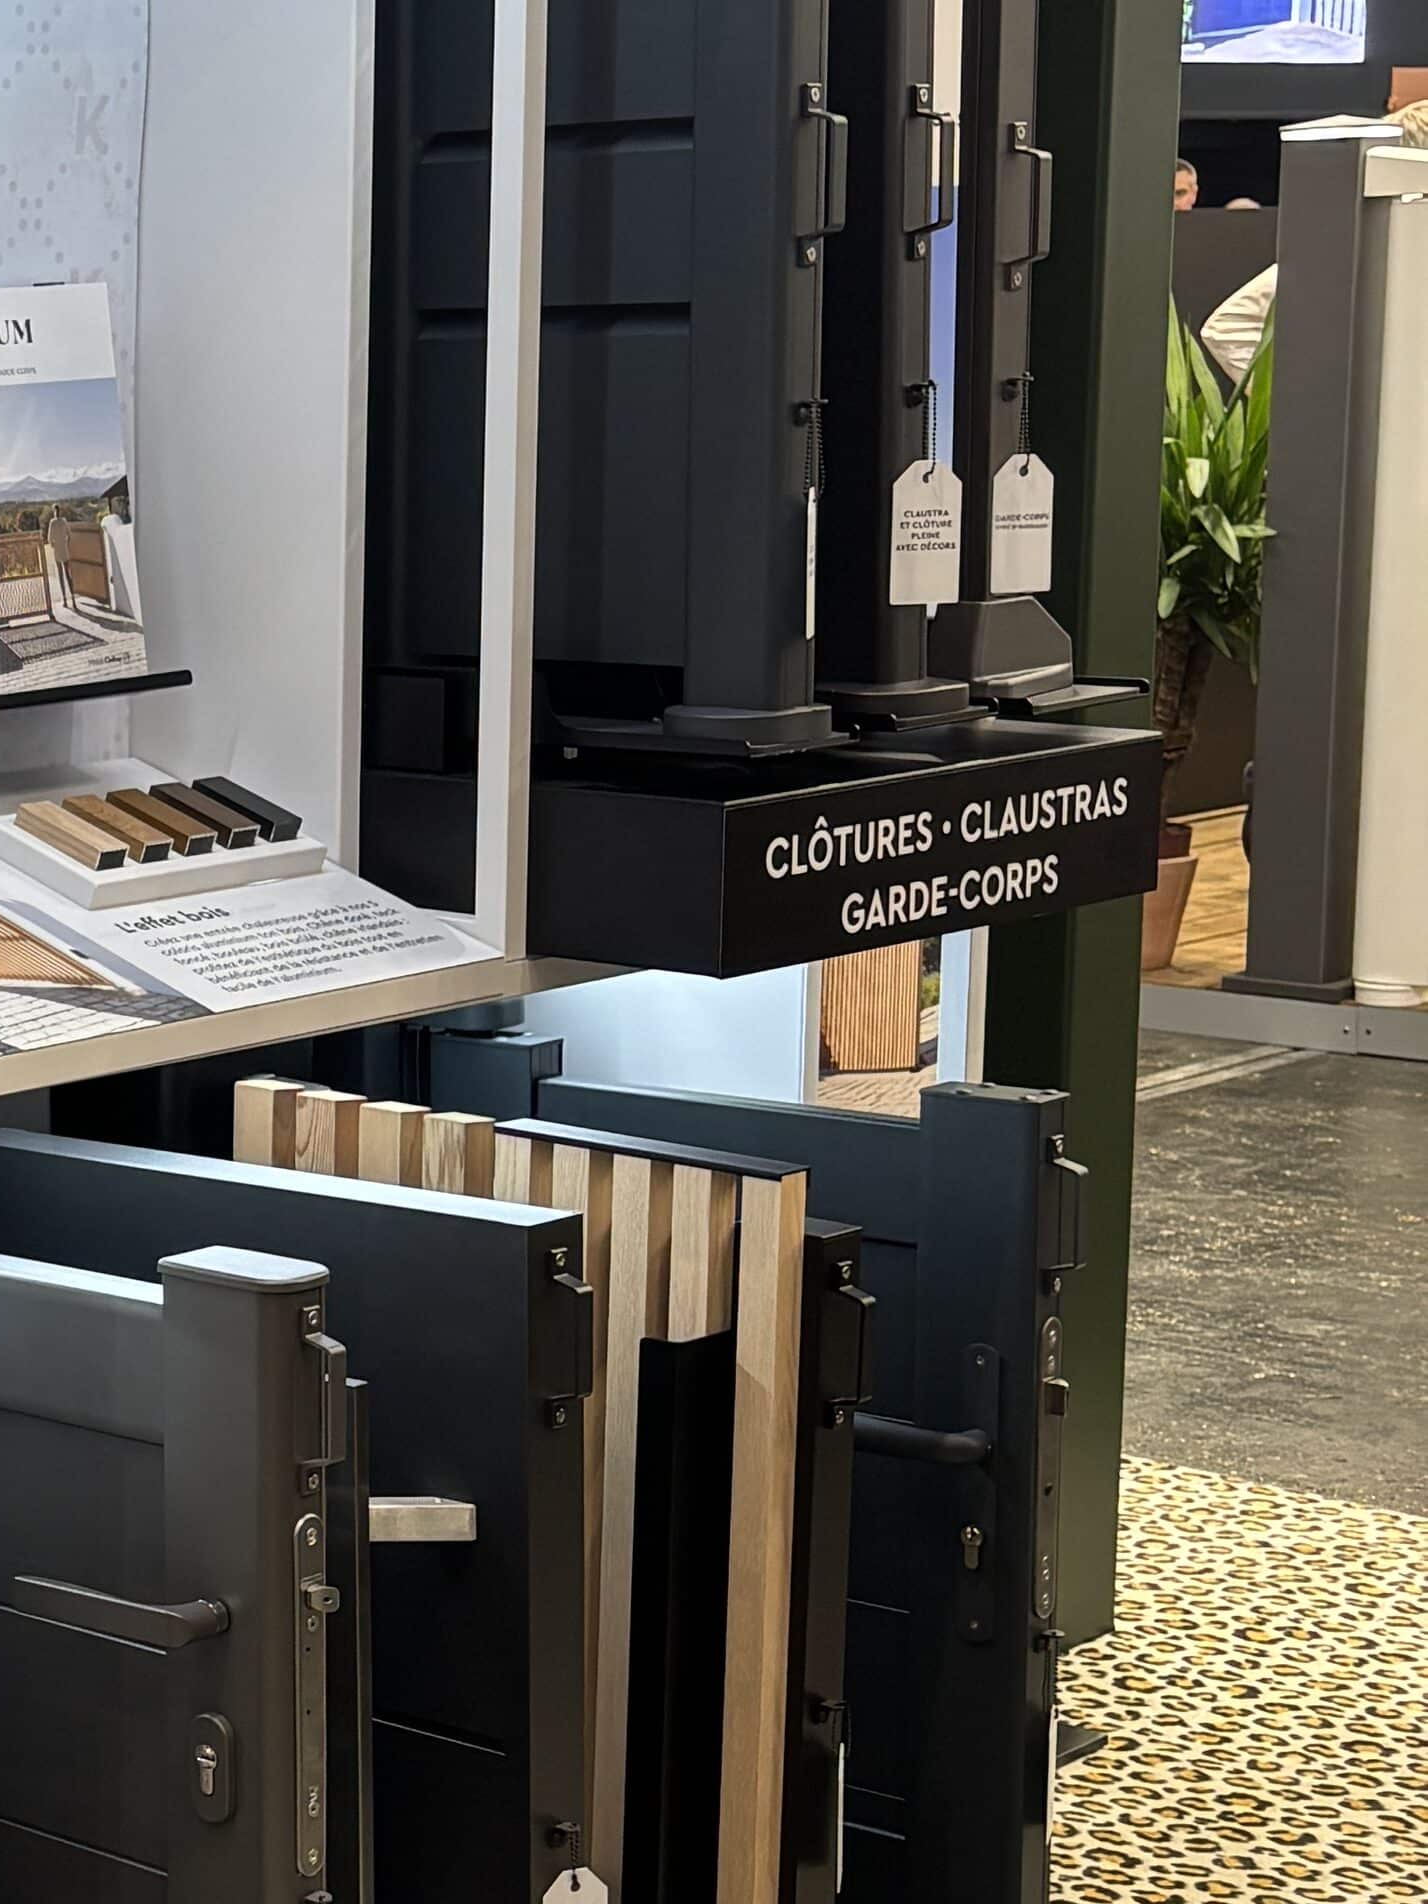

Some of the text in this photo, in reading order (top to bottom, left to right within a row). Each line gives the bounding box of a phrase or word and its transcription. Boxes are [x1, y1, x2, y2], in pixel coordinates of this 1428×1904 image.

[75, 95, 110, 155] K
[903, 509, 949, 518] CLAUSTRA
[920, 541, 956, 551] DÉCORS
[765, 777, 1128, 881] CLÔTURES CLAUSTRAS
[841, 854, 1060, 936] GARDE-CORPS
[114, 913, 185, 935] L'effet
[178, 906, 231, 923] bois
